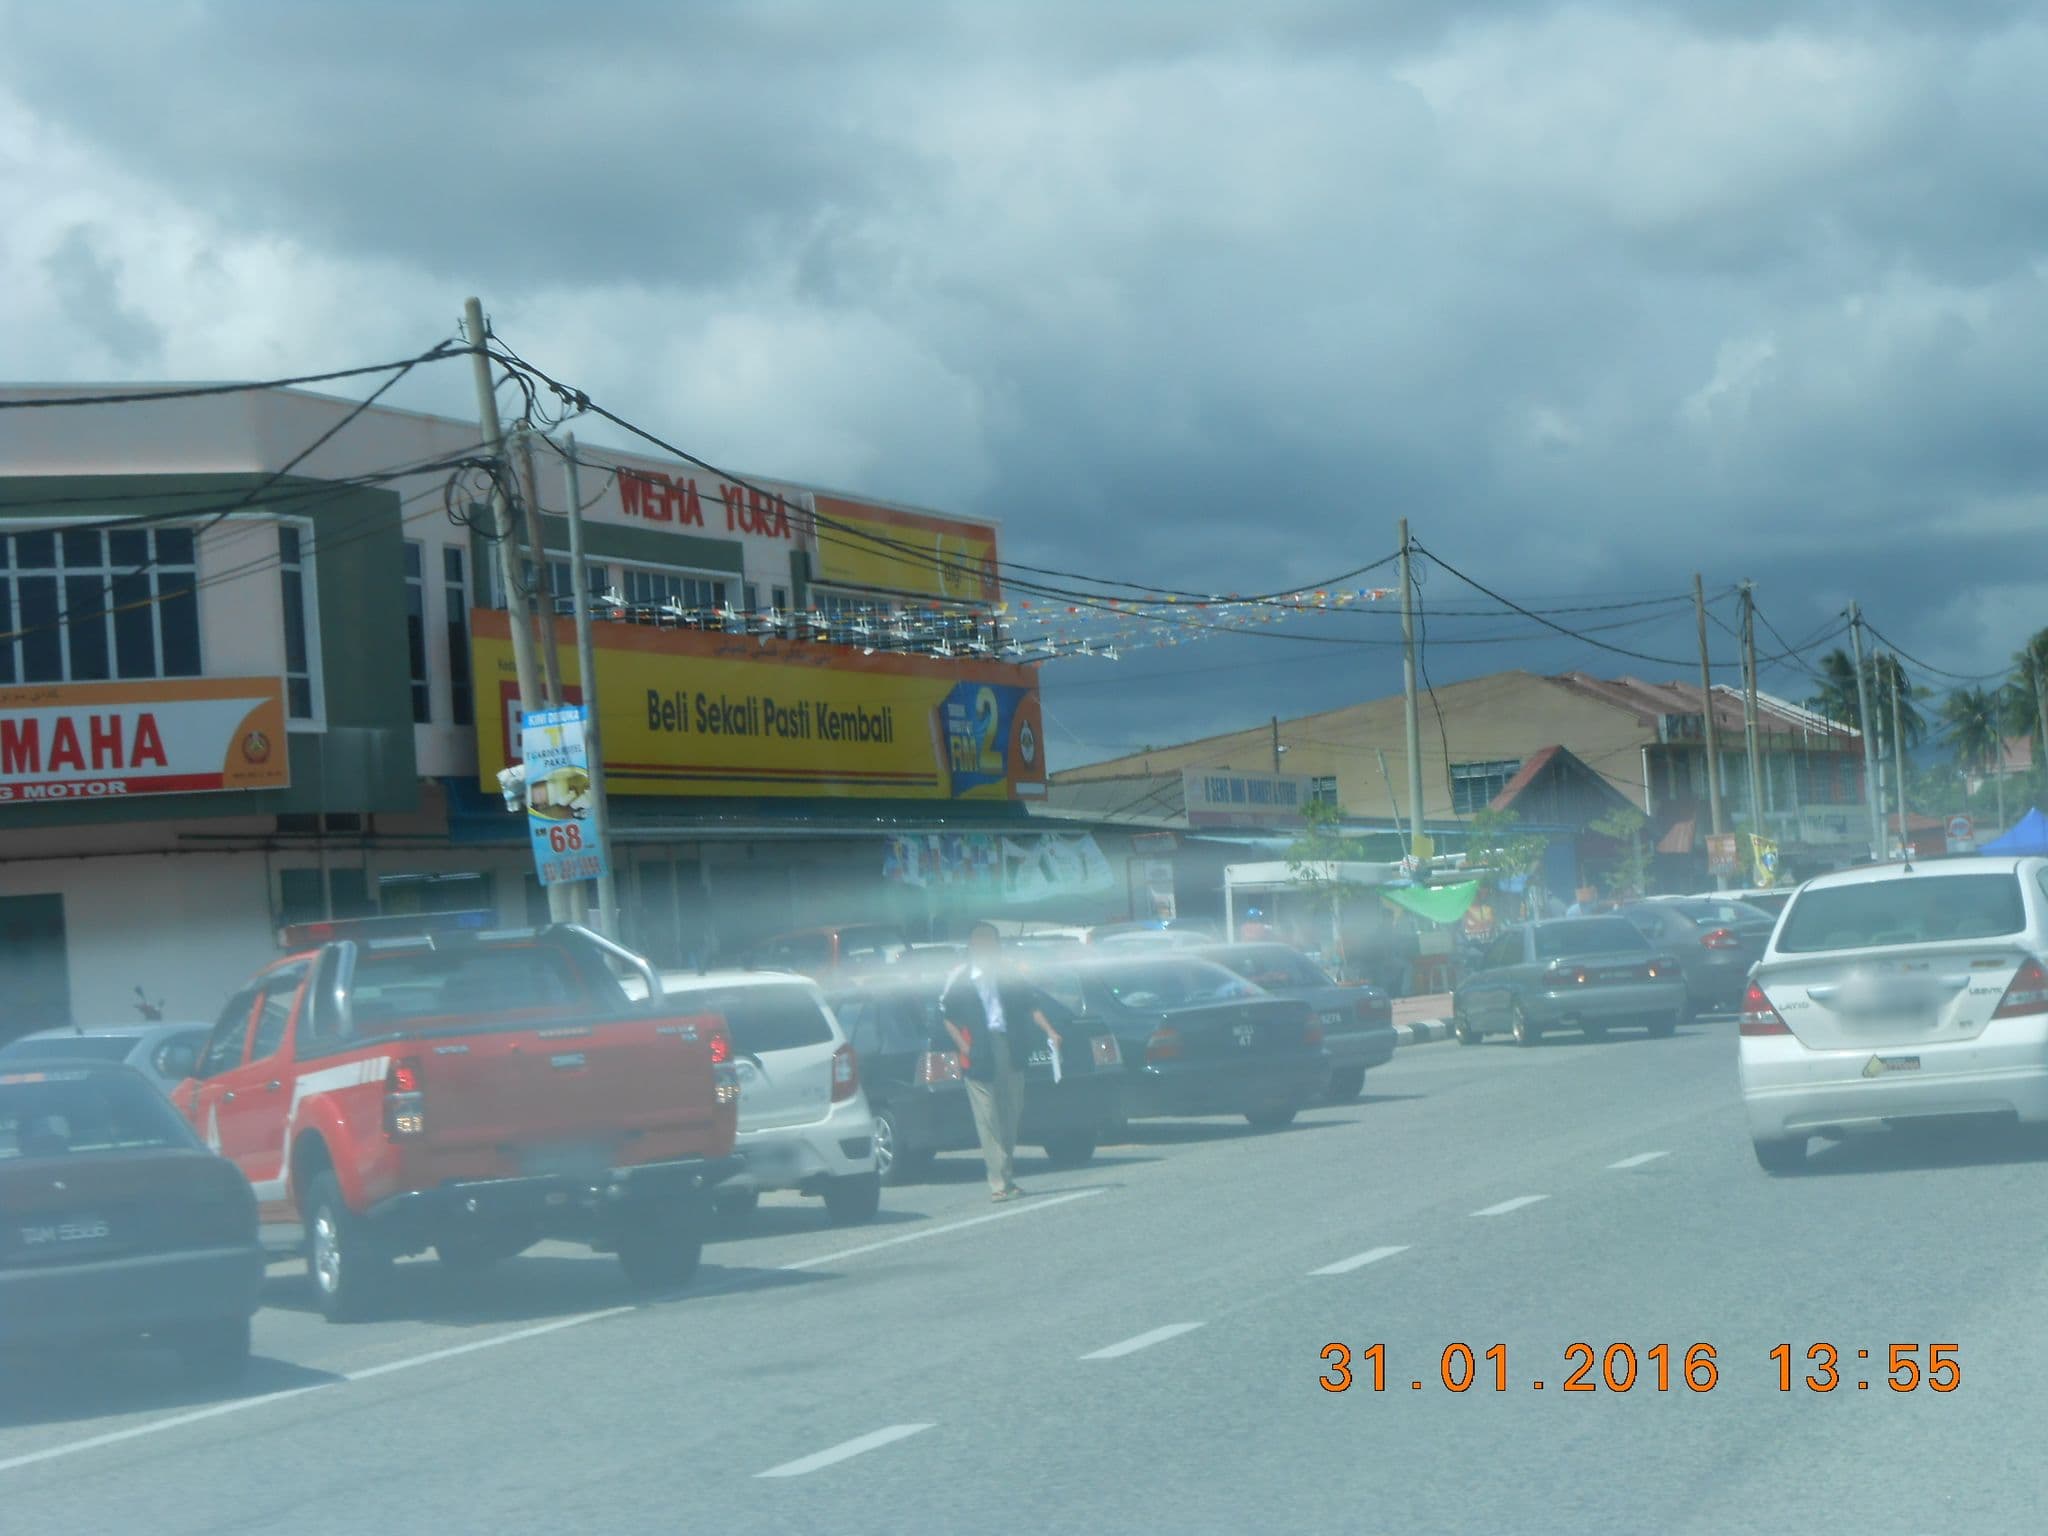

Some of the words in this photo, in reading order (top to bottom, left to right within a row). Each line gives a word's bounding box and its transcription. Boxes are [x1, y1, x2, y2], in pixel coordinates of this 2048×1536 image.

[616, 466, 704, 528] WISMA
[719, 483, 792, 539] YURA
[647, 689, 688, 732] Beli
[695, 692, 759, 736] Sekali
[763, 697, 810, 739] Pasti
[816, 701, 893, 743] Kembali
[0, 713, 168, 775] MAHA
[23, 781, 127, 799] MOTOR
[550, 823, 582, 853] 68
